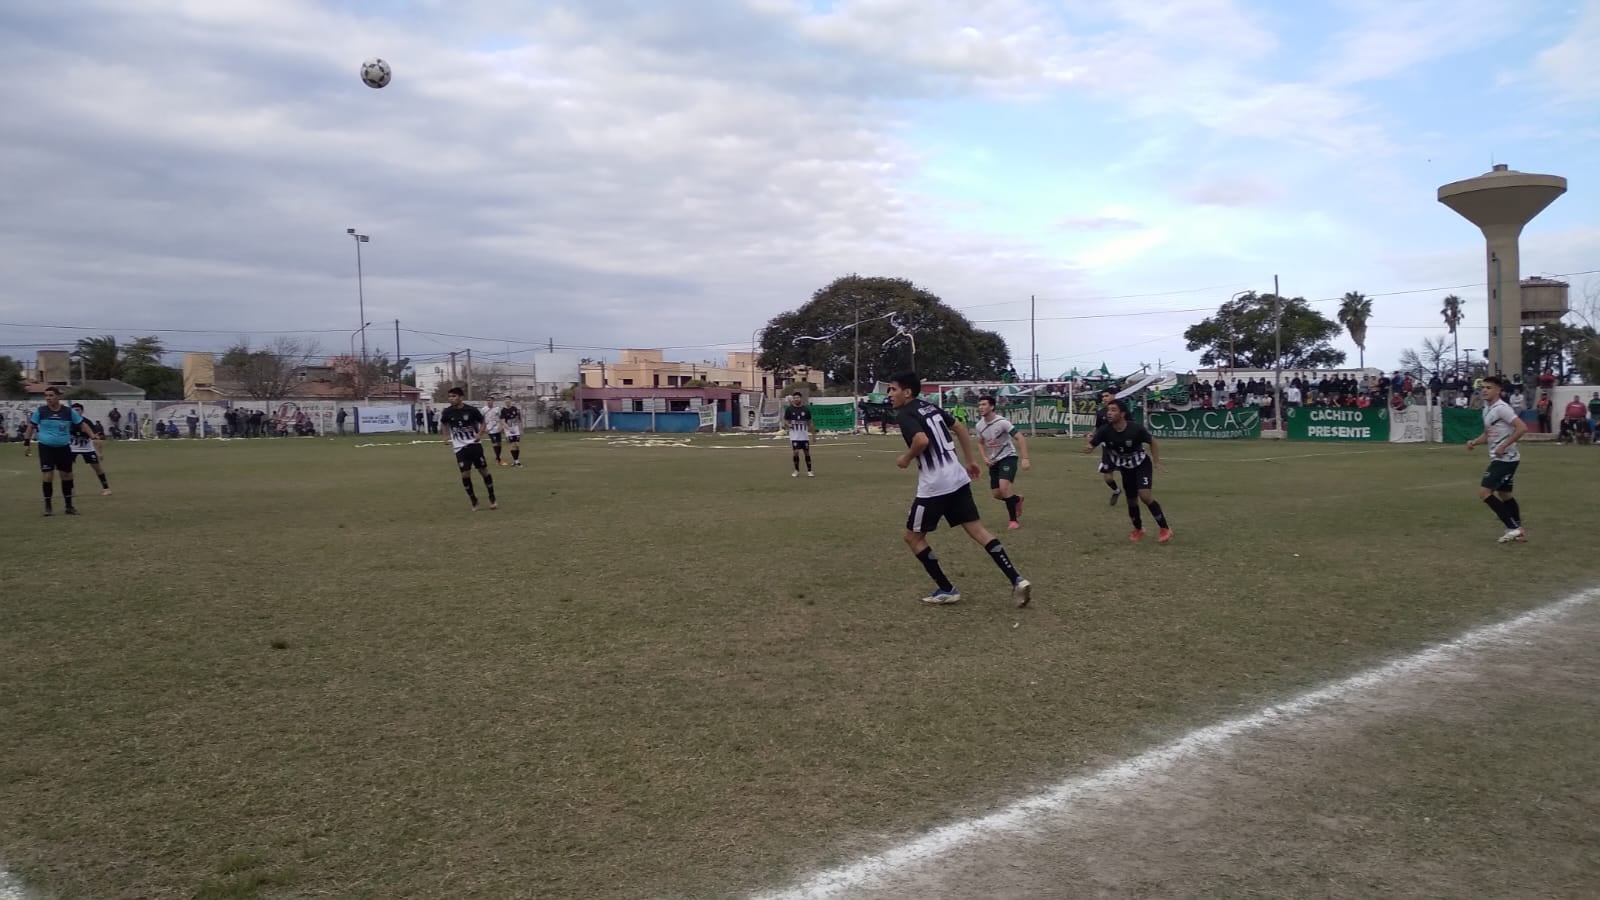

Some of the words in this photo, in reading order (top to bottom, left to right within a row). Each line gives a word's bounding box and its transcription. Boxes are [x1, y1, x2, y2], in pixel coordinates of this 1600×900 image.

[1310, 409, 1363, 422] CACHITO
[926, 413, 956, 454] 10
[1307, 426, 1371, 438] PRESENTE
[1143, 477, 1149, 485] 3
